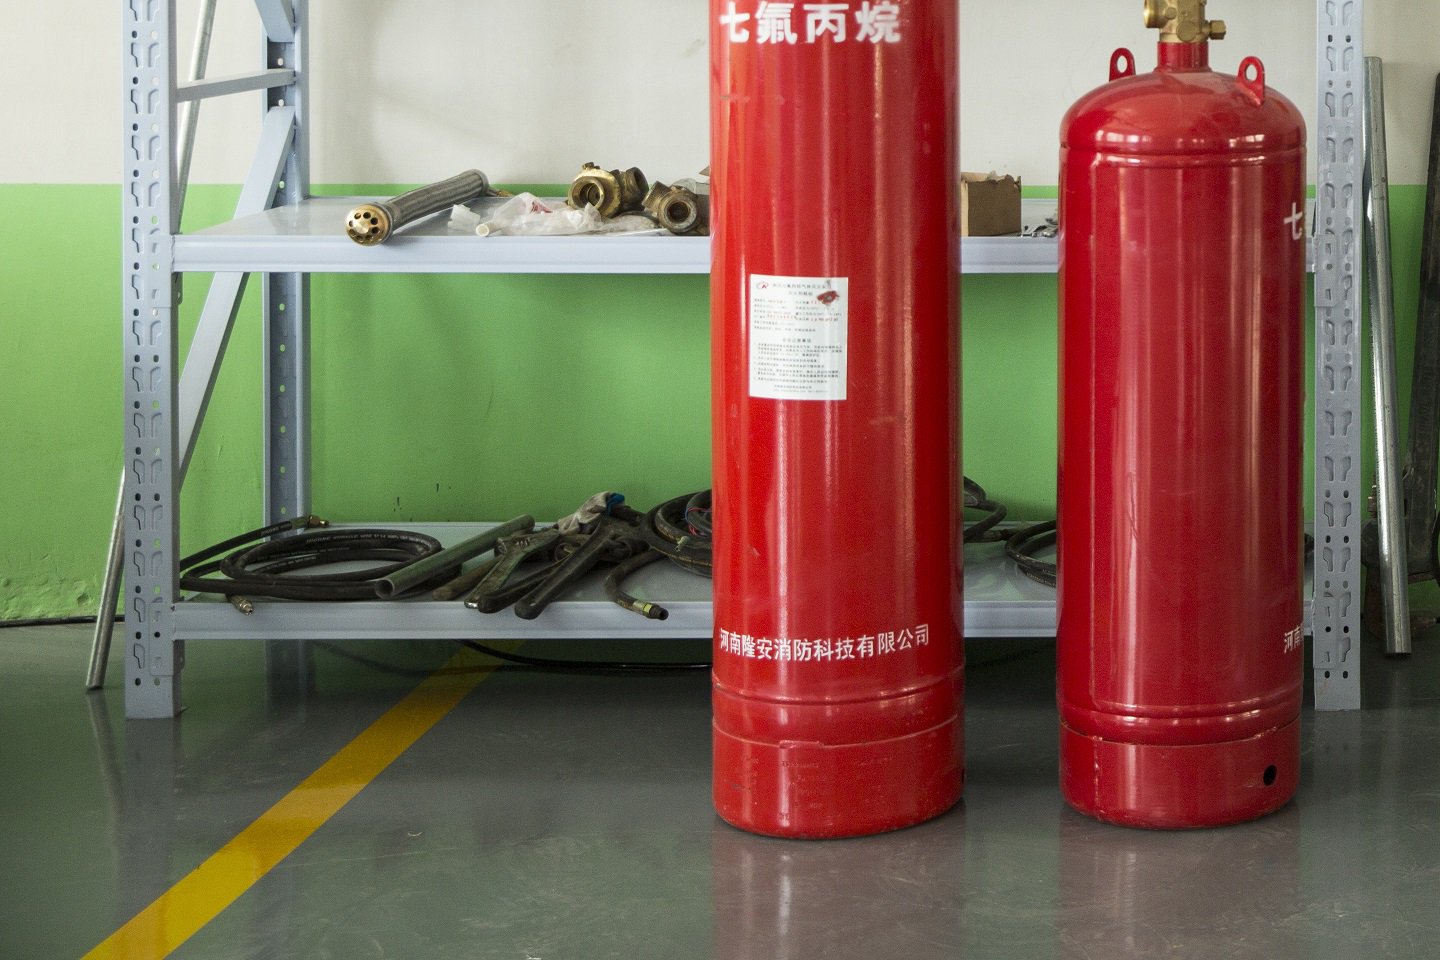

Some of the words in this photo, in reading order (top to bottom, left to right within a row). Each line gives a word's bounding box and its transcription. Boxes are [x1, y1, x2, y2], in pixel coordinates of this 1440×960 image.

[719, 0, 901, 44] 七氟丙烷
[720, 623, 929, 662] 河南隆安消防科技有限公司
